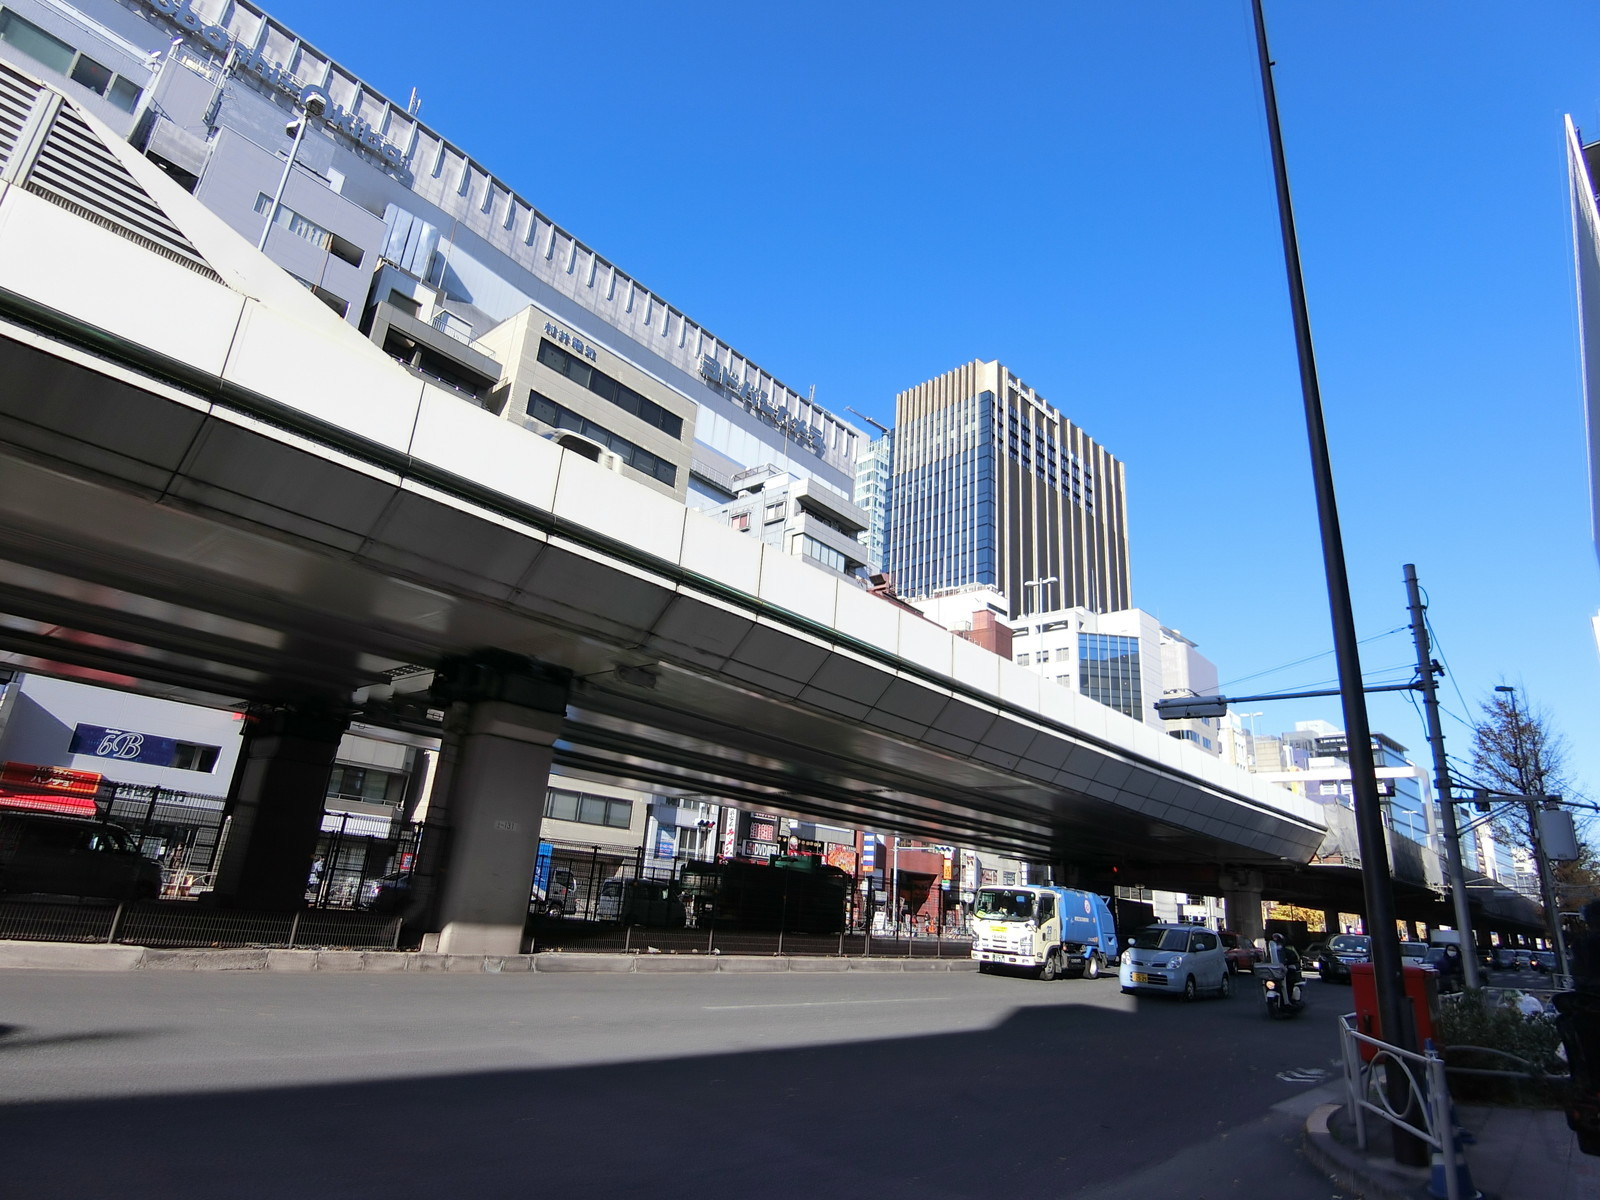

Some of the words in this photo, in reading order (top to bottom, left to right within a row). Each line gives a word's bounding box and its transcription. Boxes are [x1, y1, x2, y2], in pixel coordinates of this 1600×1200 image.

[698, 352, 825, 448] ヨドバシカメラ
